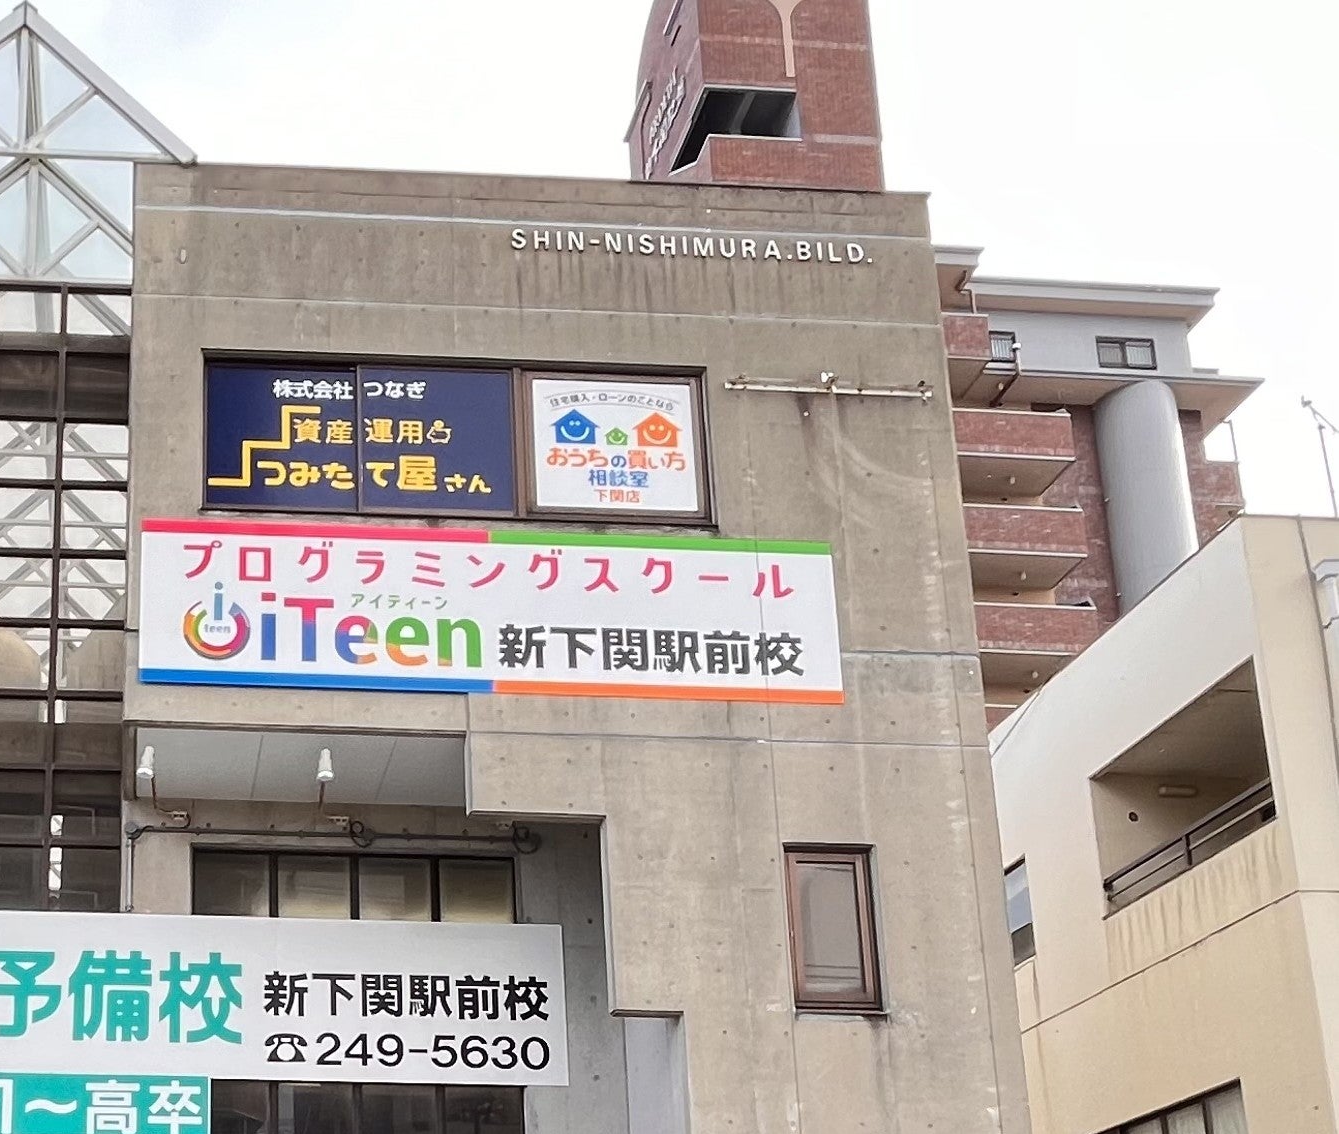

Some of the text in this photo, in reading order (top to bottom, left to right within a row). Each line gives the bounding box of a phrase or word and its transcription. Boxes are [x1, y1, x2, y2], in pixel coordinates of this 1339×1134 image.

[546, 446, 687, 472] おうちの買い方
[588, 468, 650, 488] 相談室
[593, 488, 641, 504] 下関店
[183, 540, 794, 598] プログラミングスクール
[351, 593, 448, 610] アイティーン
[260, 592, 483, 668] iTeen
[499, 623, 804, 676] 新下関駅前校
[263, 971, 550, 1022] 新下関駅前校
